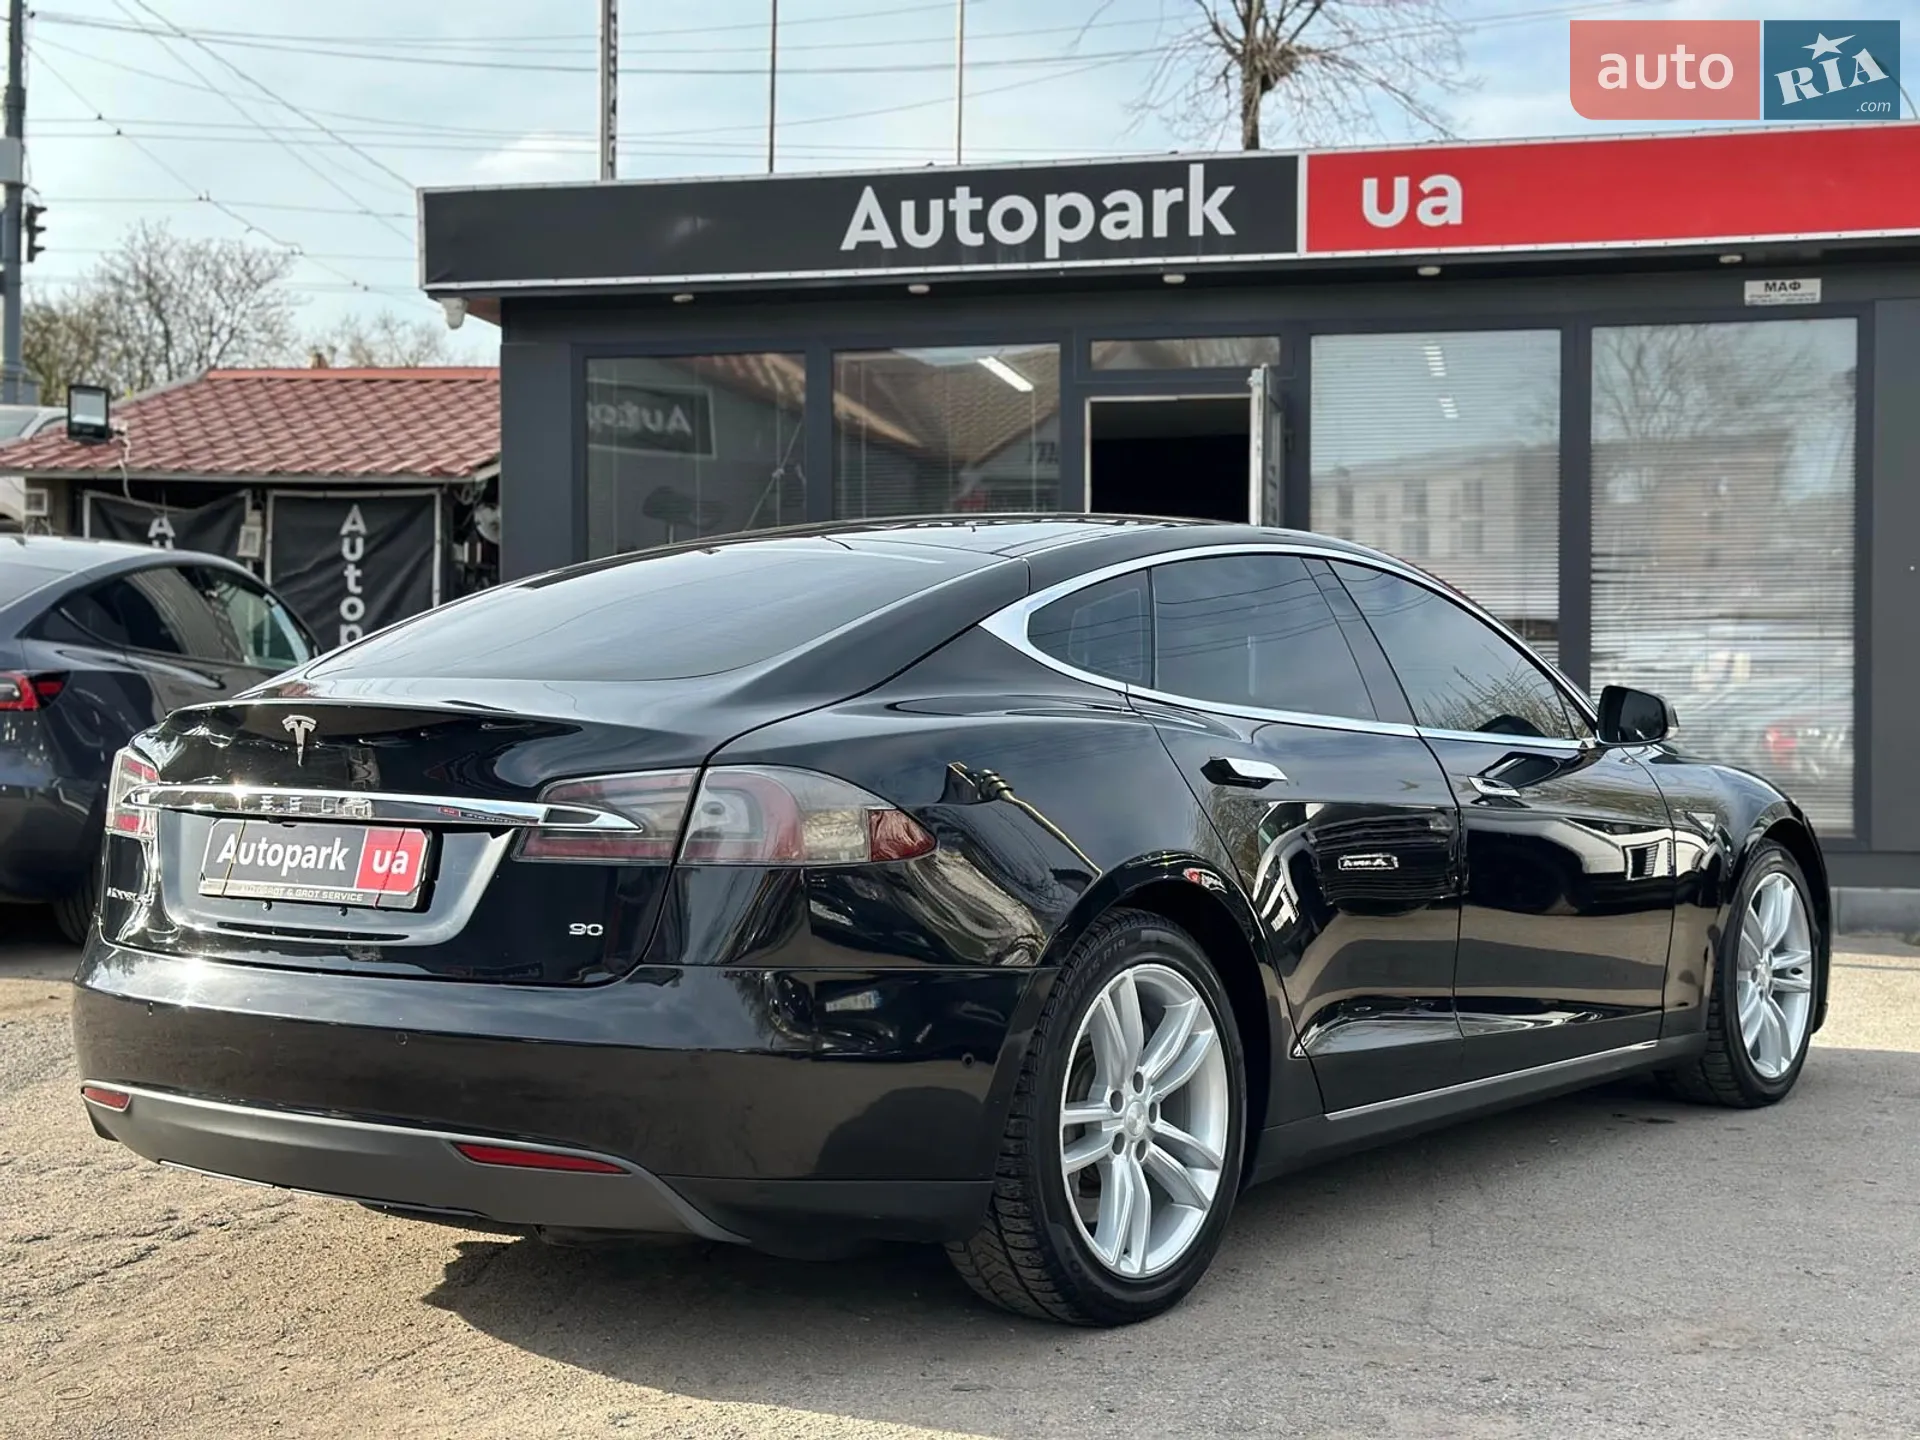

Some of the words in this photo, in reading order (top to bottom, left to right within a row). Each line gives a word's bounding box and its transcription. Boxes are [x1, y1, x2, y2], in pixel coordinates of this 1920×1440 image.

[839, 163, 1236, 259] Autopark
[1362, 172, 1463, 228] ua
[1764, 281, 1801, 293] МАФ
[216, 833, 349, 876] Autopark
[372, 849, 409, 875] ua
[321, 891, 364, 902] SERVICE
[568, 922, 604, 937] 90
